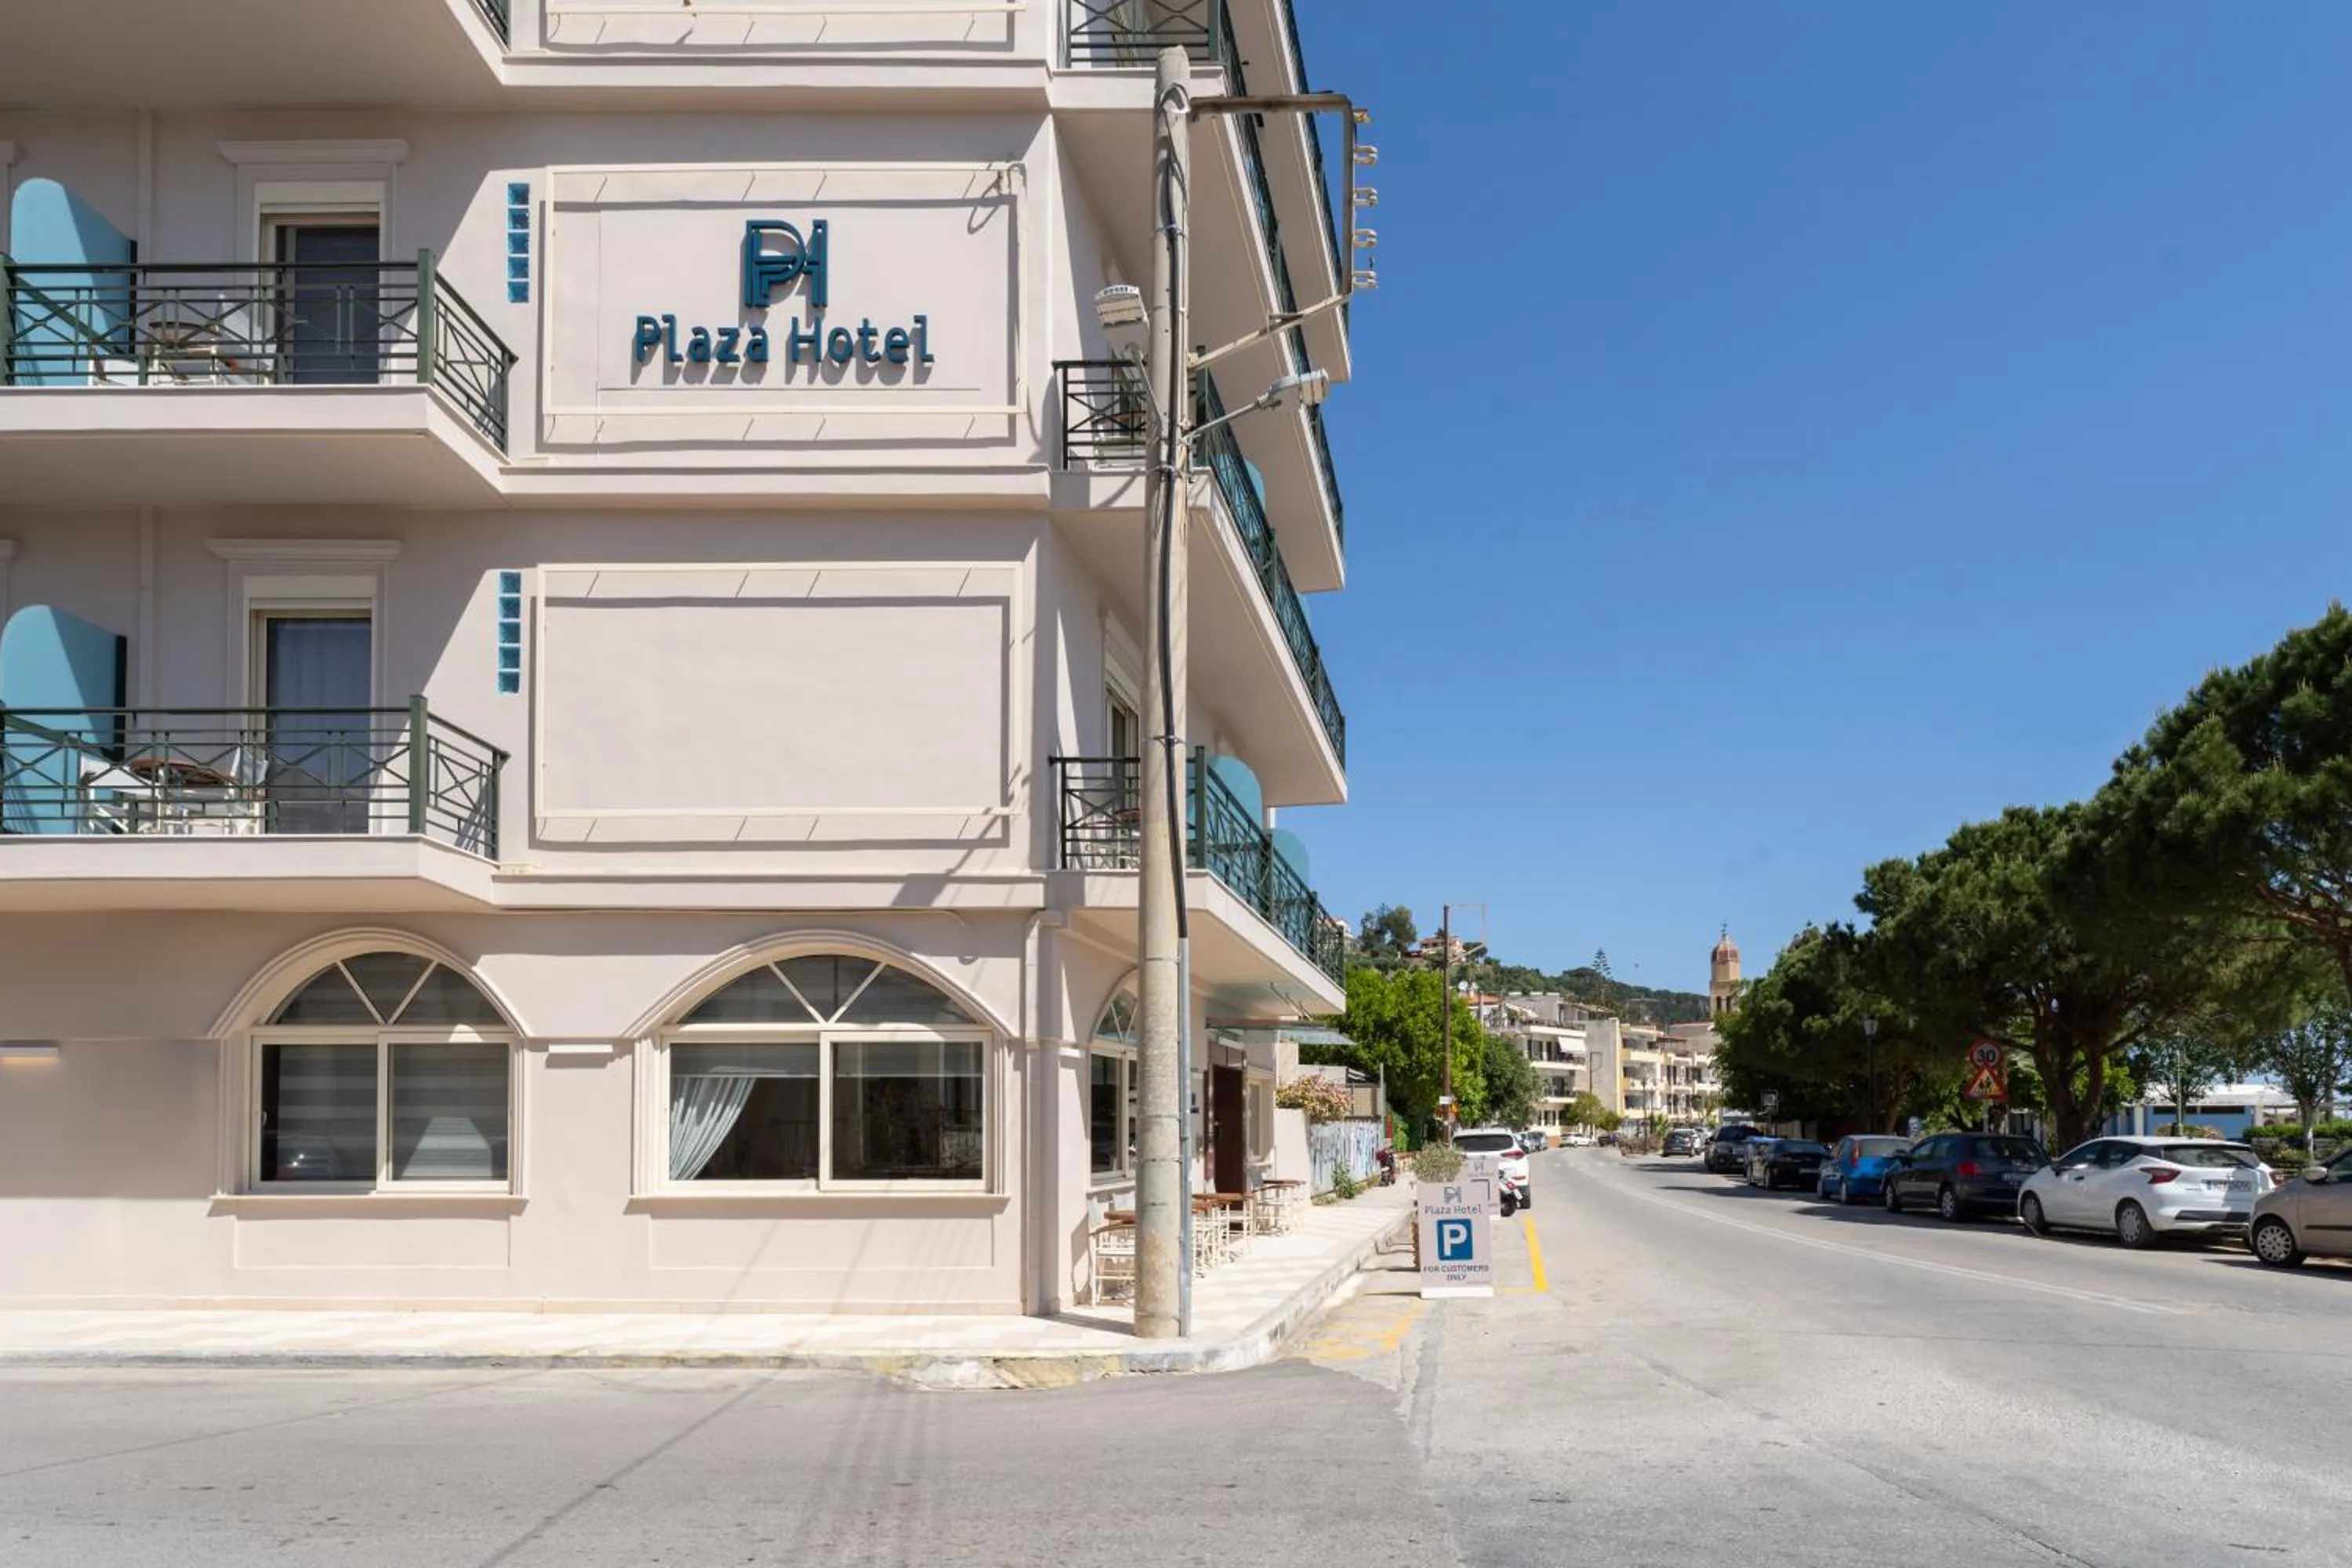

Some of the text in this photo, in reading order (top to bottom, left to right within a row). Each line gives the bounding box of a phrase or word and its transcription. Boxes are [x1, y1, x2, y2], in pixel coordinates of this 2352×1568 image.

[636, 314, 935, 364] Plaza Hotel
[1977, 1049, 1996, 1062] 30
[1425, 1203, 1483, 1214] Plaza Hotel
[1443, 1224, 1468, 1257] P
[1423, 1264, 1489, 1273] FOR CUSTOMERS
